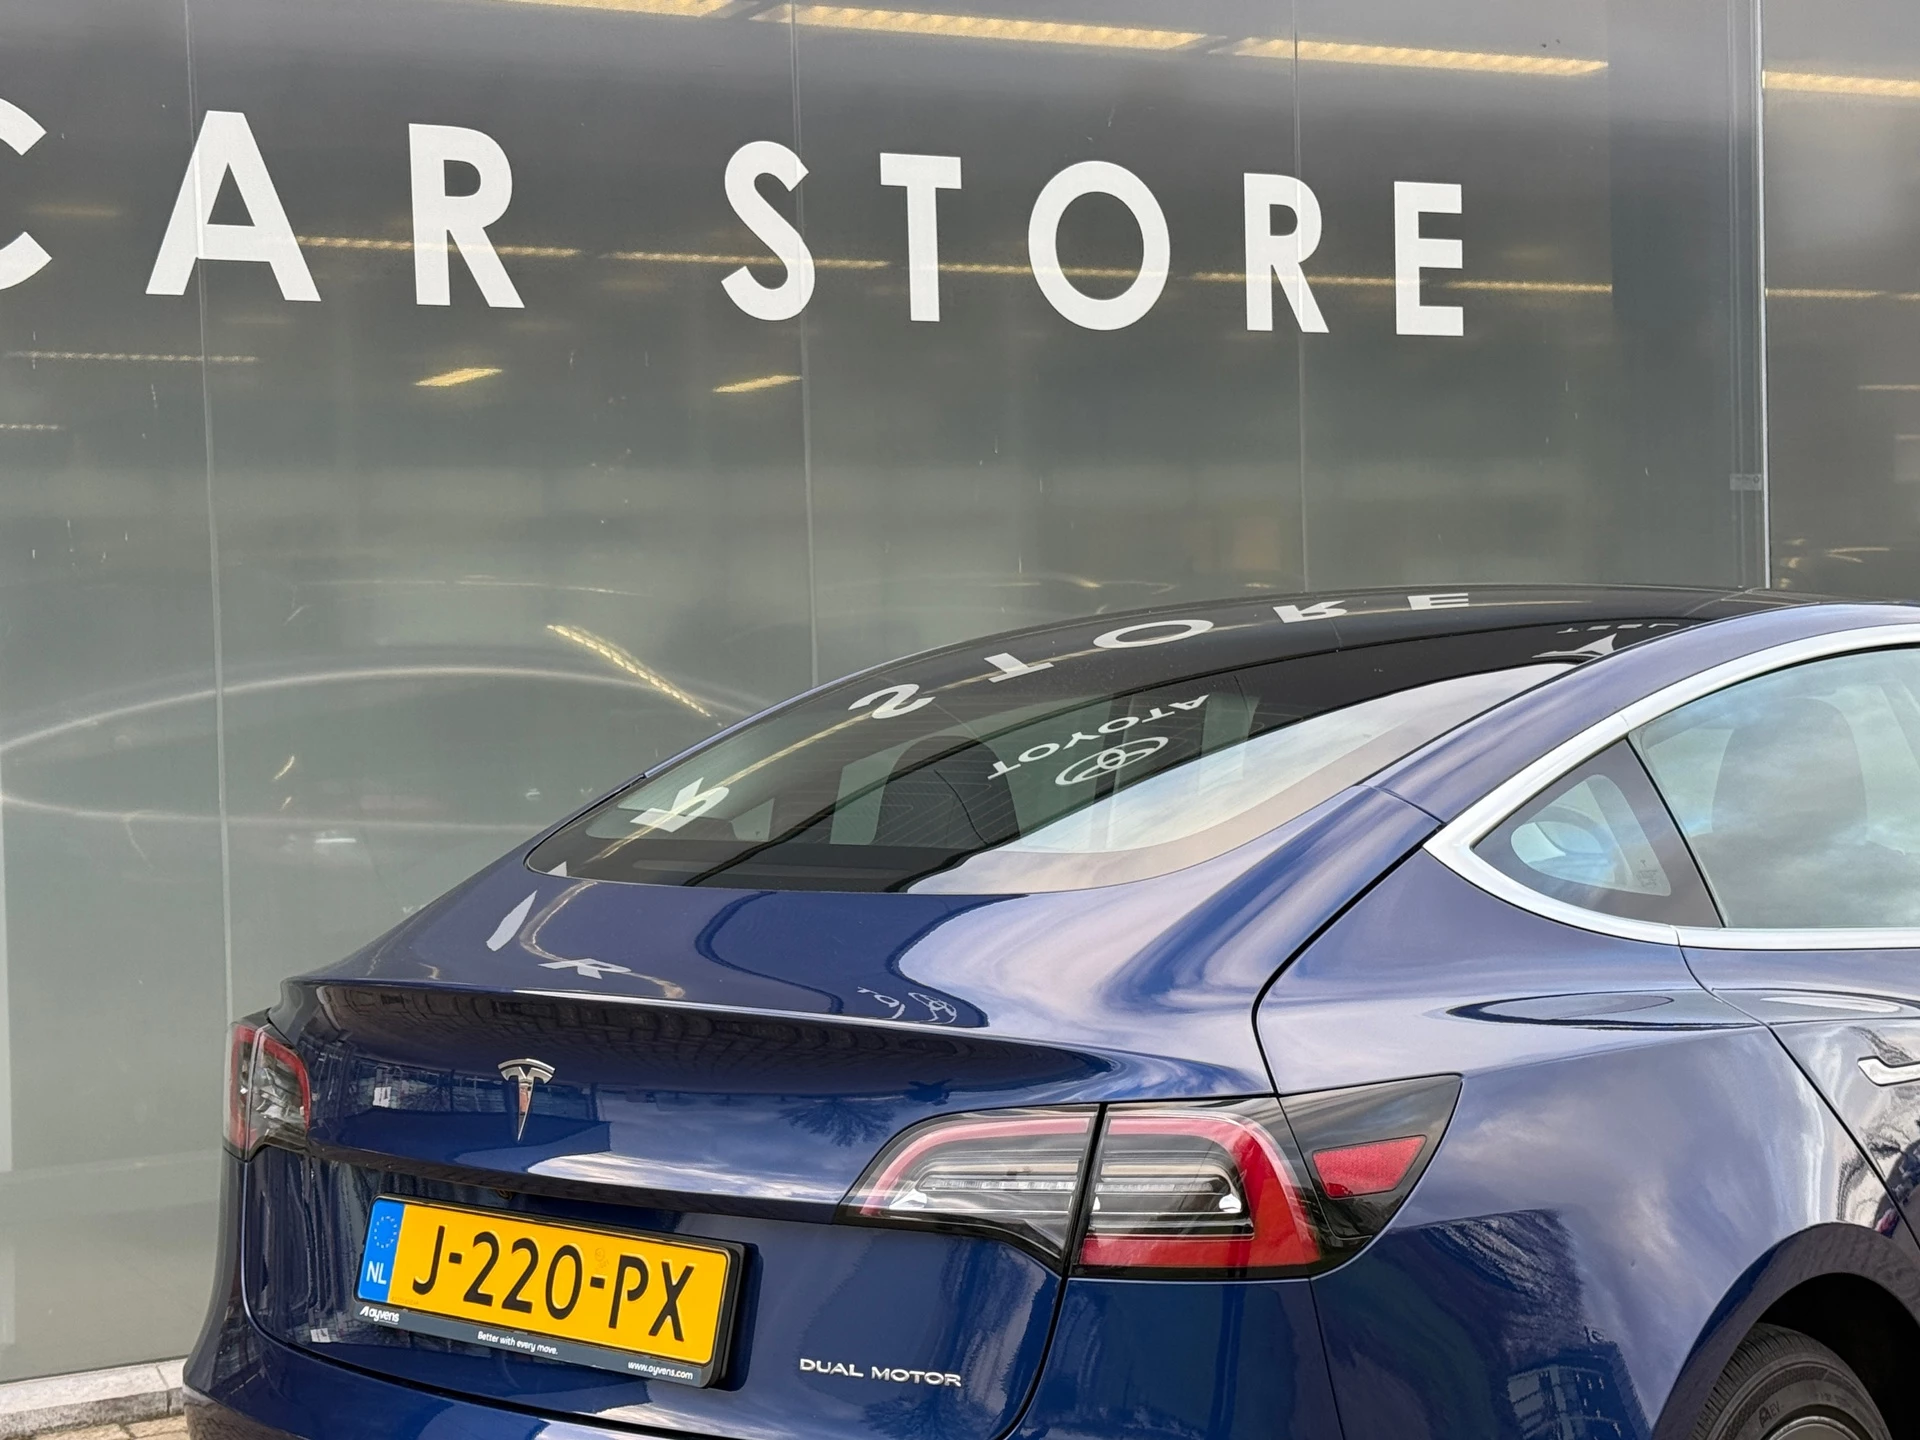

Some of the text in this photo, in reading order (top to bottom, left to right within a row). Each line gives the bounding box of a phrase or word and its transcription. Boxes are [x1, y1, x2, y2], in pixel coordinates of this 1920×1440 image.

[721, 140, 1464, 337] STORE
[365, 1260, 387, 1286] NL
[412, 1225, 695, 1341] J-220-PX
[477, 1330, 559, 1355] Better with every move.
[627, 1361, 694, 1380] www.ayvens.com
[799, 1358, 962, 1387] DUAL MOTOR
